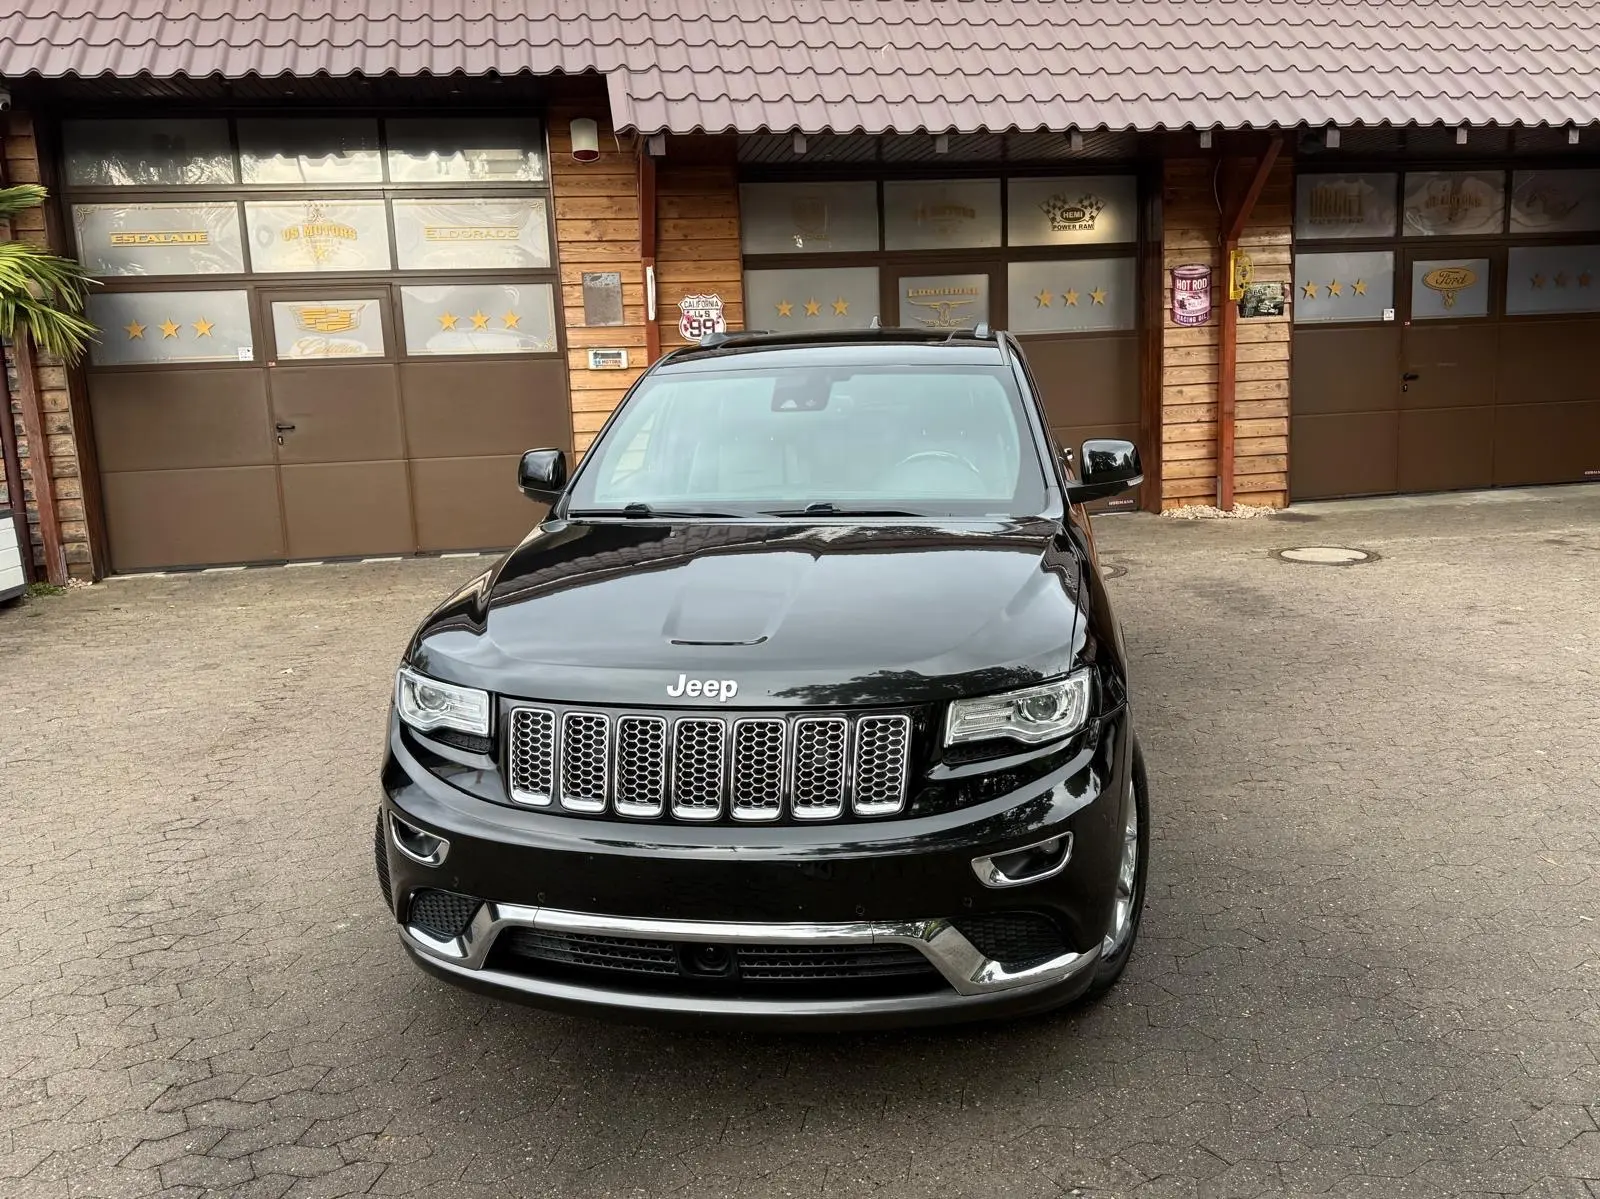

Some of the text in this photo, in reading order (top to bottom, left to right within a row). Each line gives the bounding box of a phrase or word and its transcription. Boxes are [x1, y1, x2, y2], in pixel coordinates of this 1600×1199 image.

[1063, 210, 1084, 219] HEMI
[110, 232, 208, 243] ESCALADE
[303, 223, 358, 241] MOTORS
[425, 229, 519, 239] ELDORADO
[1176, 278, 1208, 291] HOT ROD
[1435, 270, 1468, 286] Ford
[683, 300, 719, 309] CALIFORNIA
[690, 318, 716, 338] 99
[666, 673, 739, 703] Jeep
